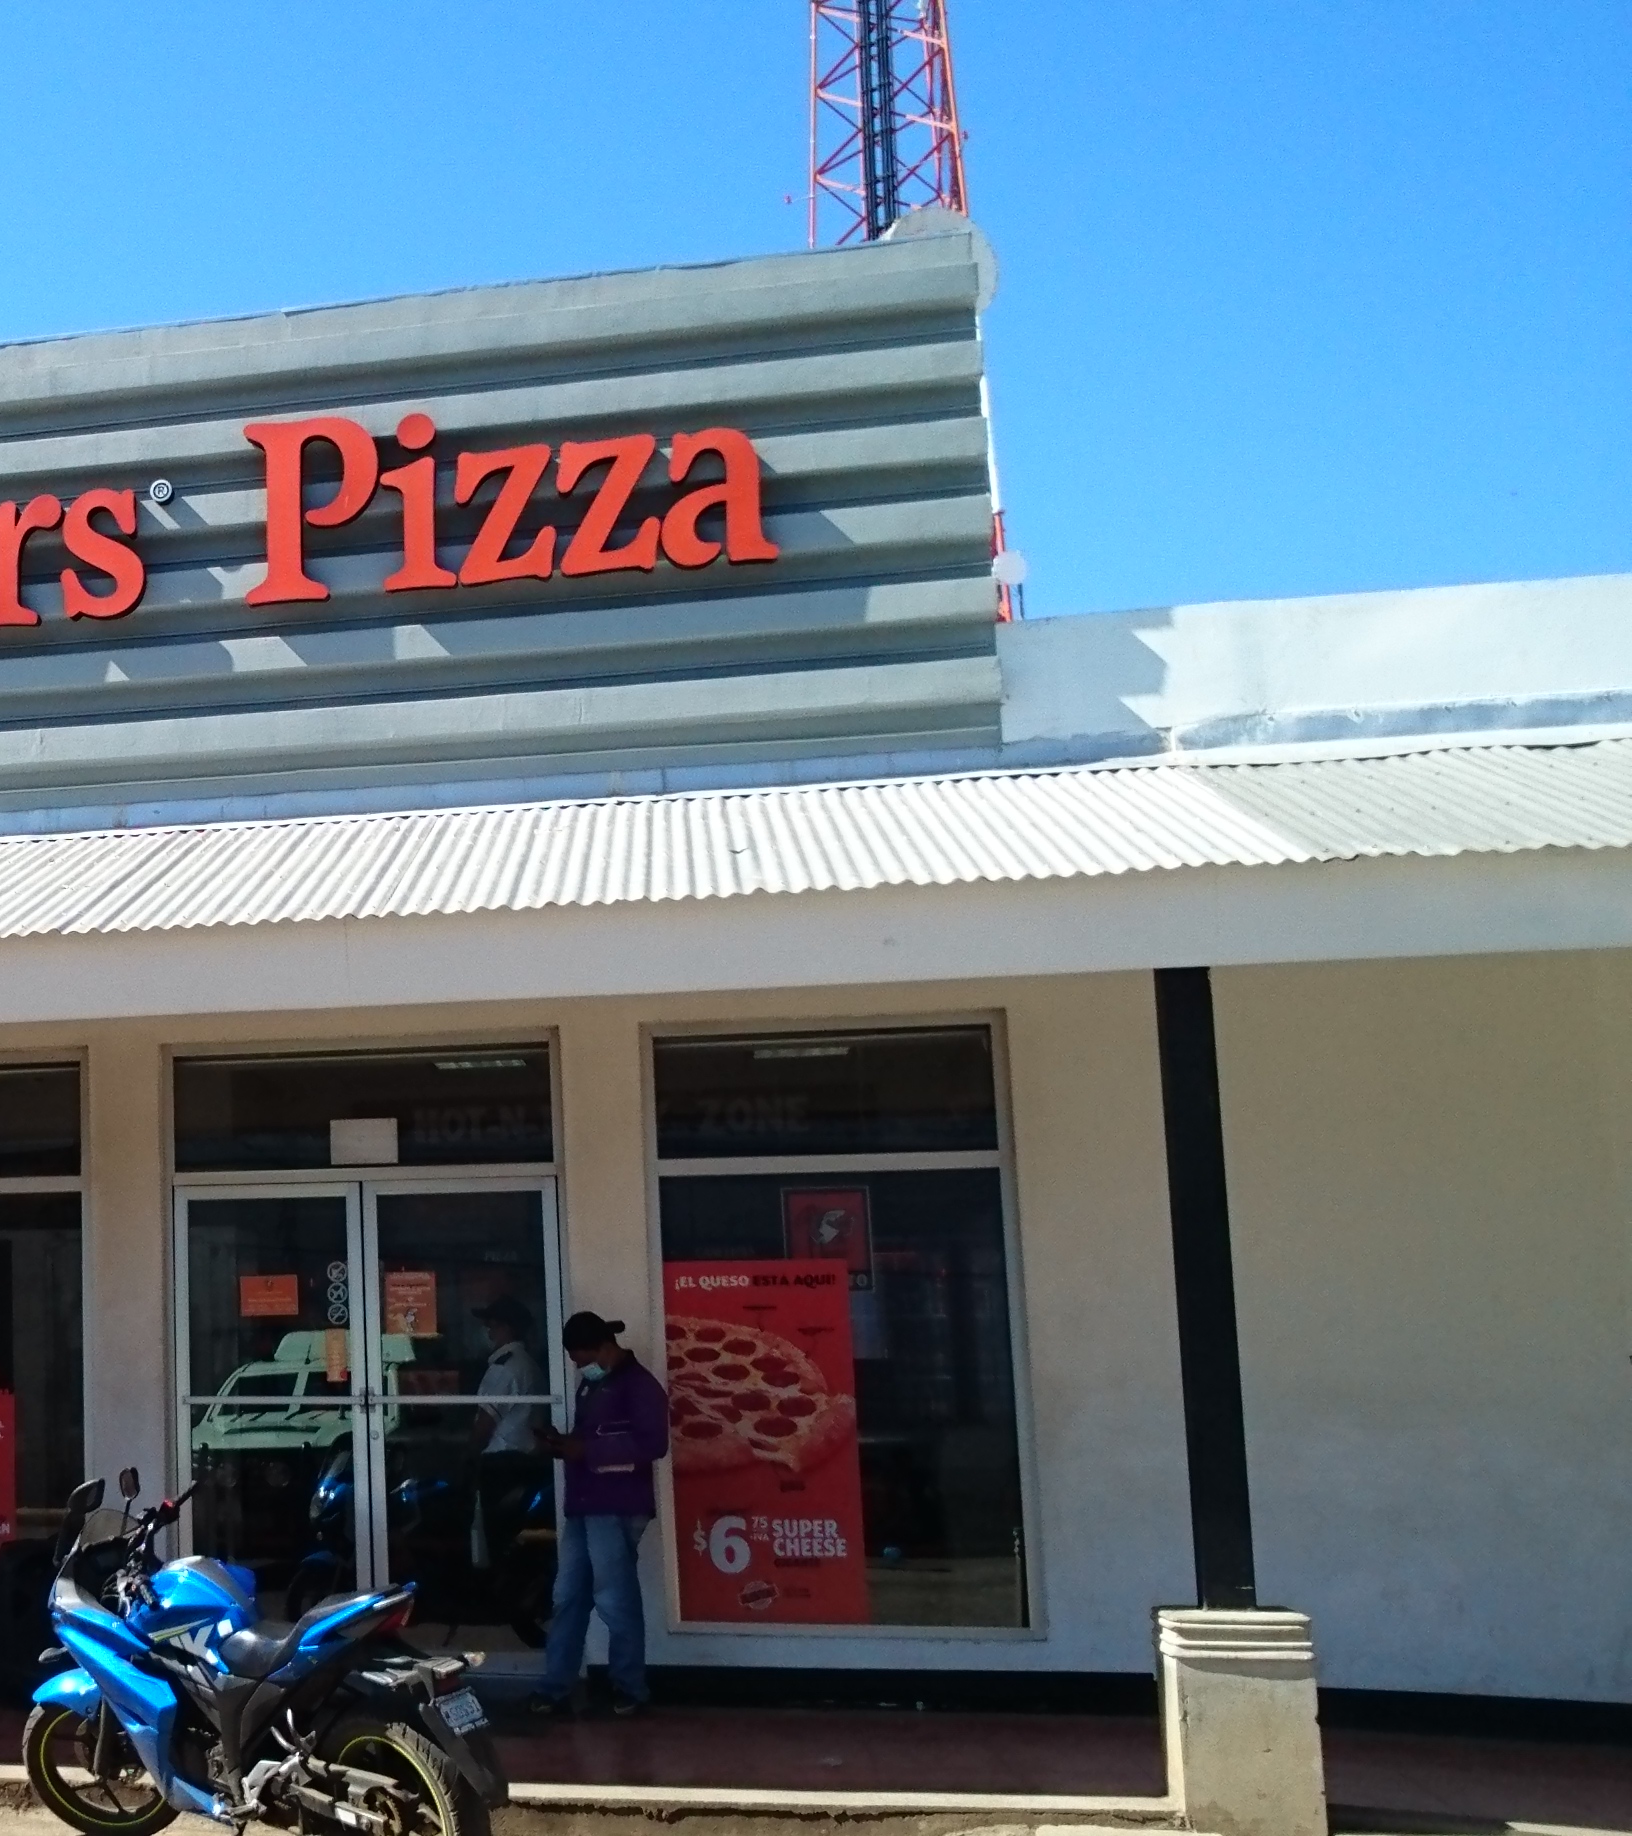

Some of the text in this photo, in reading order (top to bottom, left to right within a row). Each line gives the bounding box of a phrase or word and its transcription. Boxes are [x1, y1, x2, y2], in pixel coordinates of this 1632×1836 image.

[244, 413, 779, 606] Pizza
[699, 1275, 750, 1291] QUESO
[772, 1518, 838, 1539] SUPER
[773, 1538, 847, 1557] CHEESE
